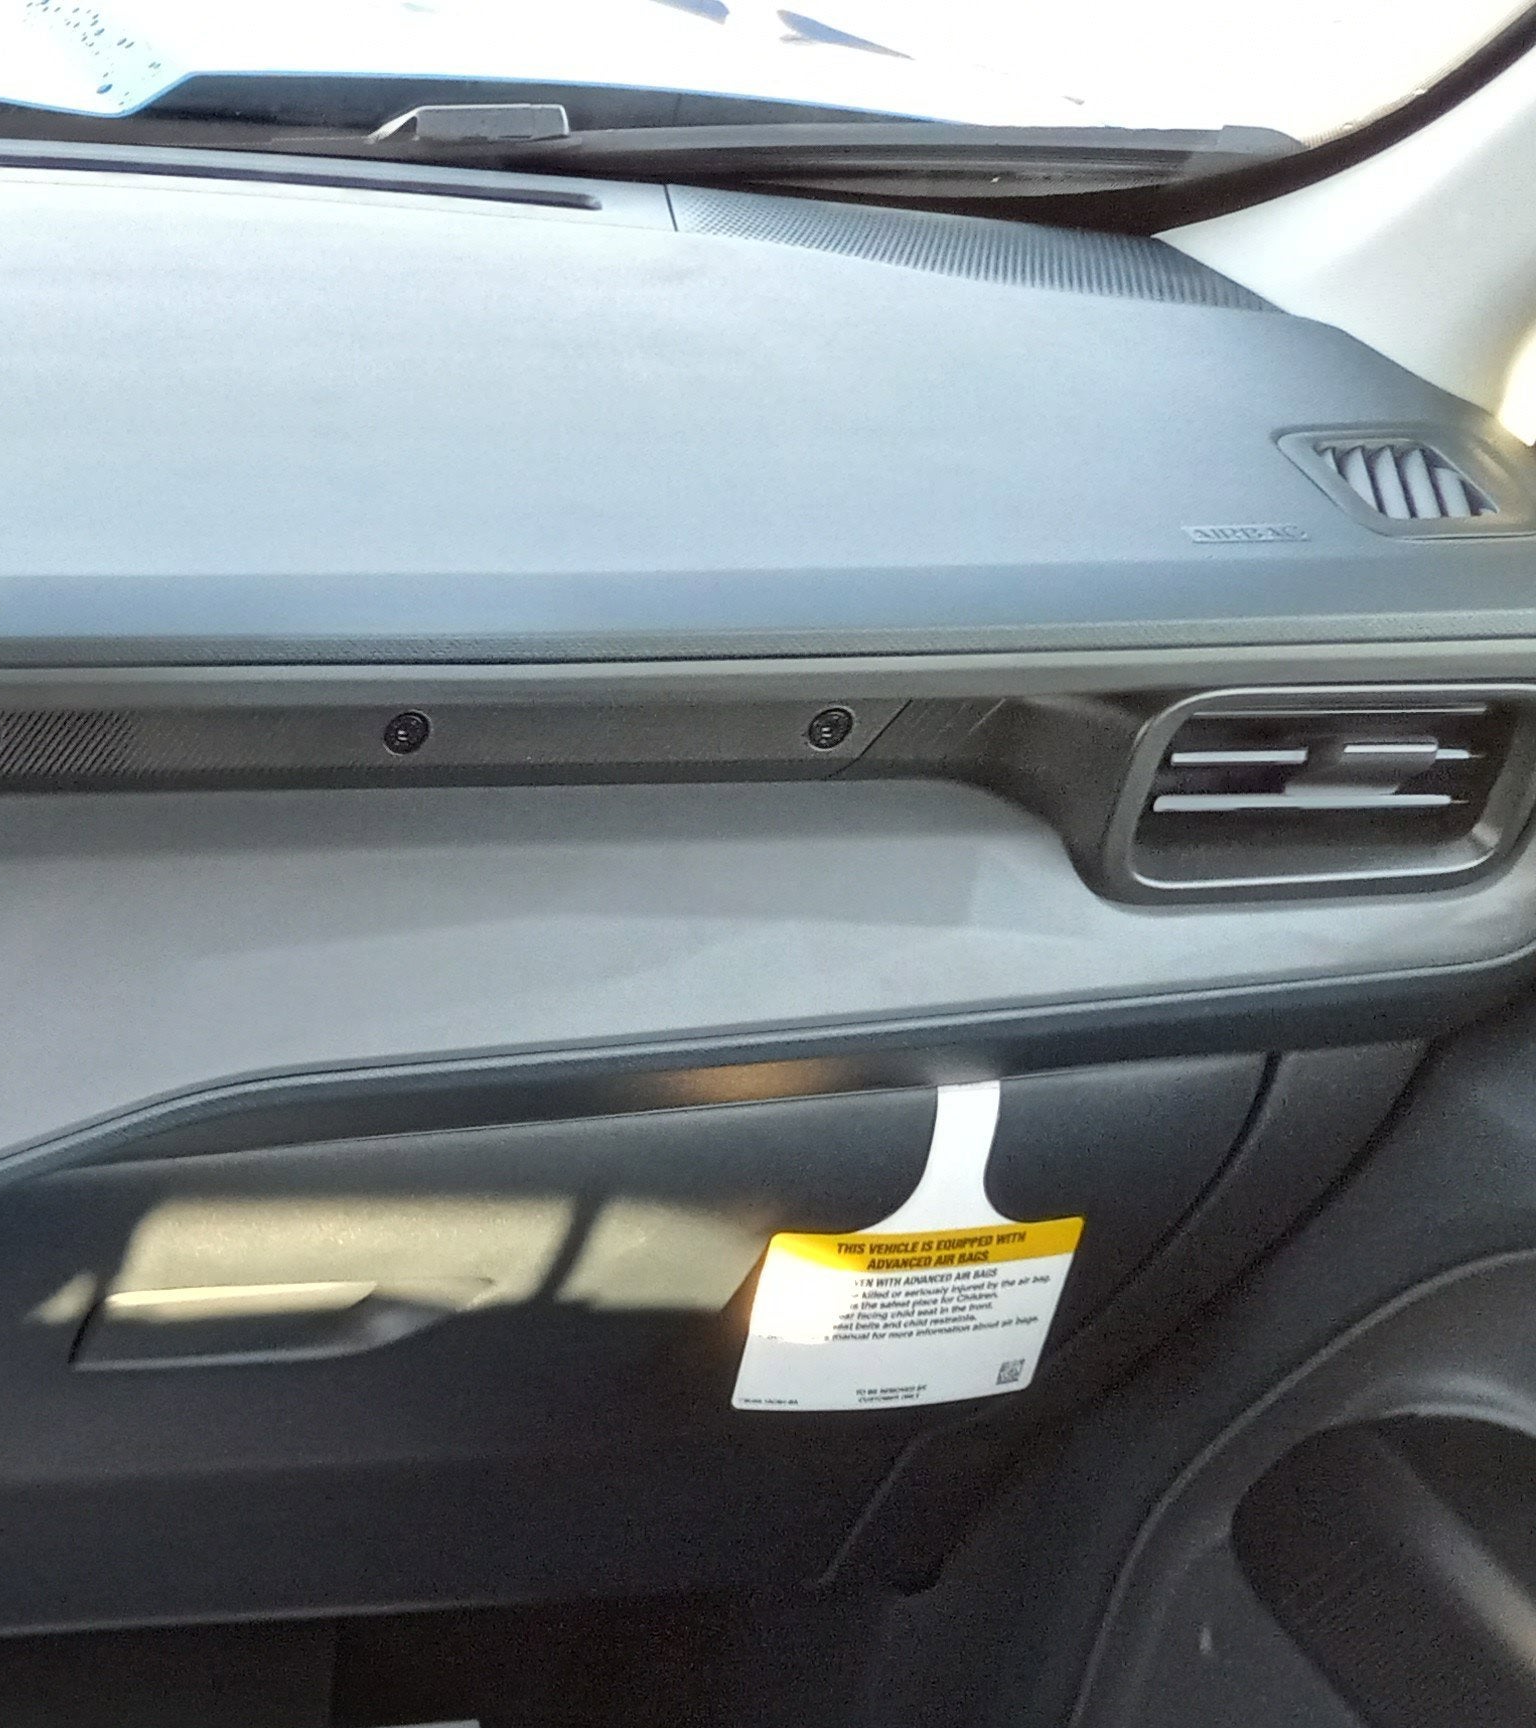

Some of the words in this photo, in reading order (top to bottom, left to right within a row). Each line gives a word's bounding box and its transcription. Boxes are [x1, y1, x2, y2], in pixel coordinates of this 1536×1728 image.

[837, 1243, 865, 1255] THIS
[868, 1241, 920, 1255] VEHICLE
[921, 1240, 933, 1251] IS
[937, 1235, 993, 1251] EQUIPPED
[996, 1232, 1026, 1246] WITH
[867, 1256, 932, 1270] ADVANCED
[934, 1255, 955, 1267] AIR
[958, 1251, 989, 1265] BAGS
[876, 1276, 902, 1287] WITH
[903, 1273, 952, 1286] ADVANCED
[954, 1271, 970, 1281] AIR
